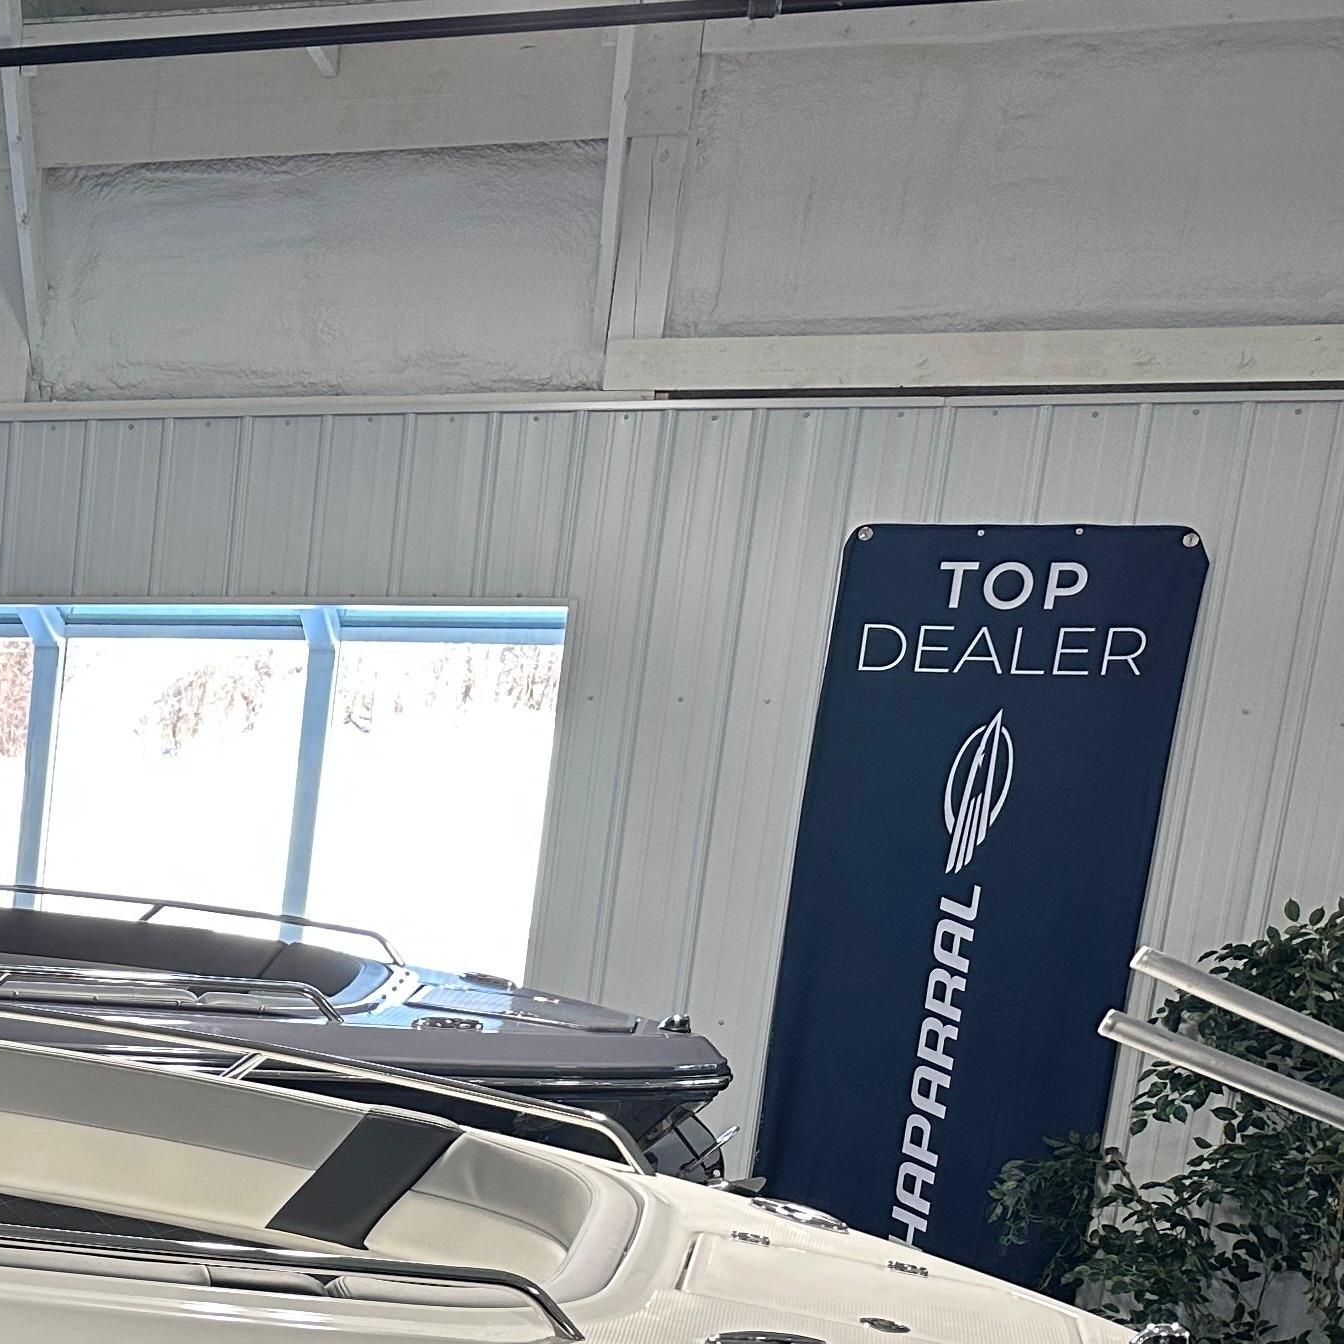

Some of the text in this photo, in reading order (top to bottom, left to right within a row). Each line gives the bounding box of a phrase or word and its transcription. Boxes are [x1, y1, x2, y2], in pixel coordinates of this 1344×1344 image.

[940, 561, 1089, 610] TOP
[857, 623, 1148, 676] DEALER
[887, 884, 982, 1252] HAPARRAL
